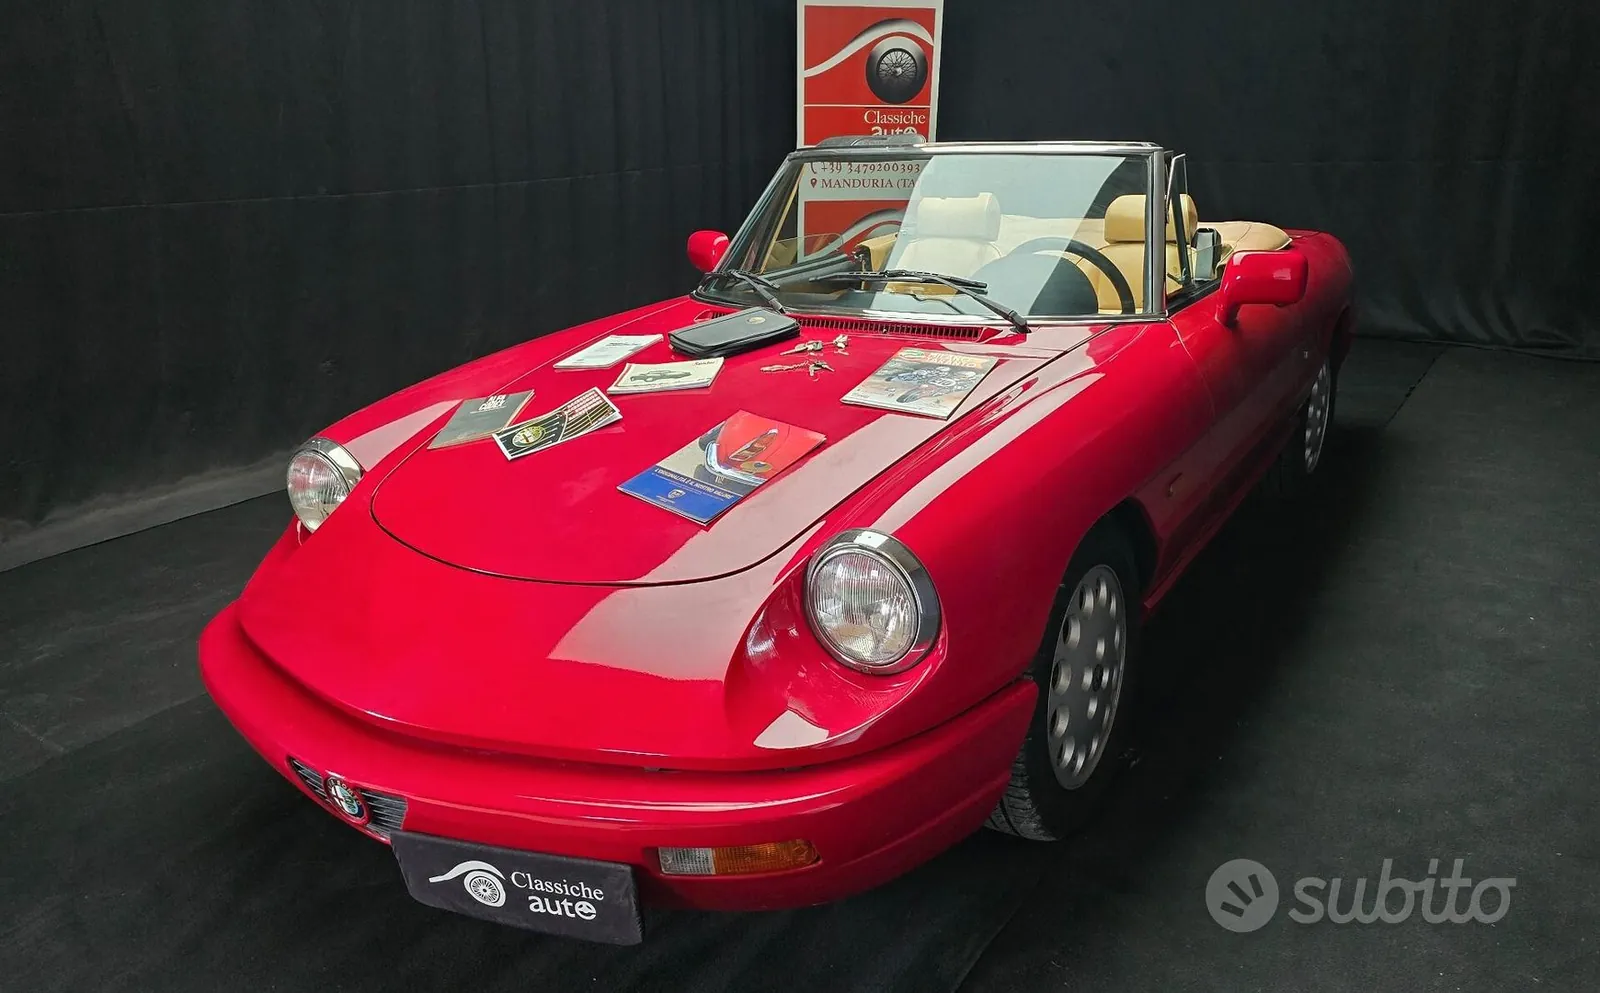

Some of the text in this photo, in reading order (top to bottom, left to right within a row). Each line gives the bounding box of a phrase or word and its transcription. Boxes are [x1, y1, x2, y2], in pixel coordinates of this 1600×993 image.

[864, 110, 926, 124] Classiche
[821, 161, 920, 174] +39 3479200393
[821, 178, 894, 189] MANDURIA
[510, 871, 604, 901] Classiche
[528, 895, 597, 921] auto
